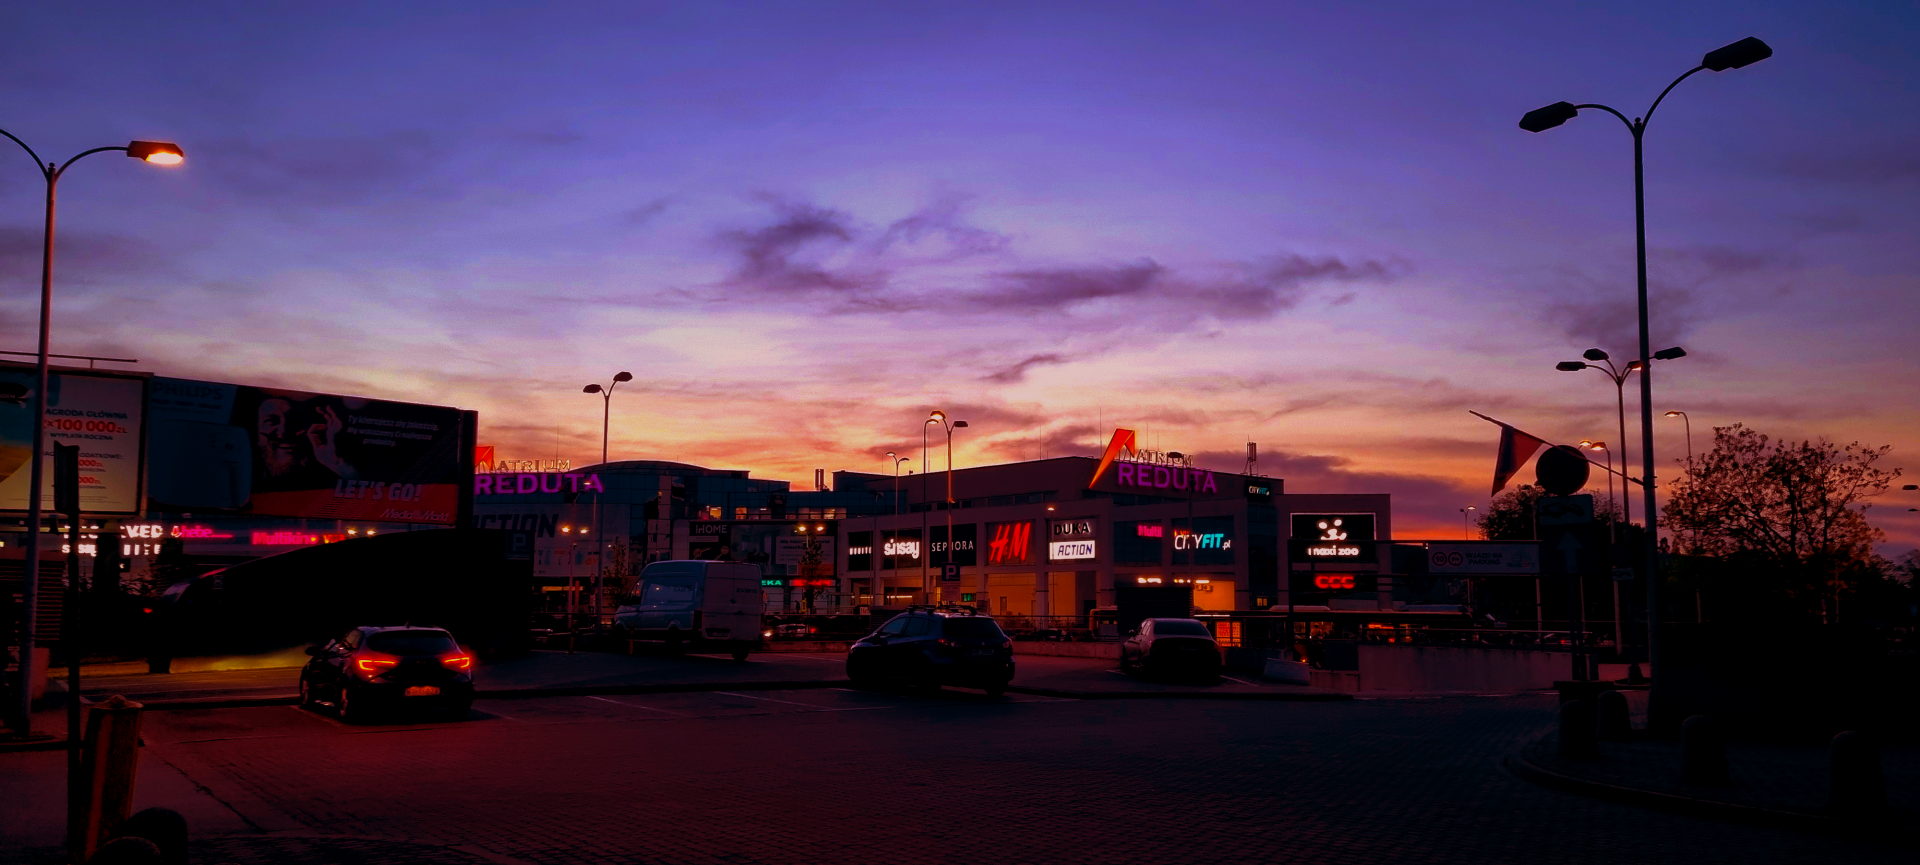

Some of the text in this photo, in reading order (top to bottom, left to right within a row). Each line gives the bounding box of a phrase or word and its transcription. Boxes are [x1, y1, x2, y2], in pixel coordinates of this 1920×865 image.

[152, 381, 223, 400] PHILIPS
[45, 408, 84, 417] AGRODA
[348, 415, 358, 424] Ty
[44, 418, 83, 432] x100
[497, 459, 571, 471] ATRIUM
[475, 473, 605, 495] REDUTA
[1118, 463, 1218, 494] REDUTA
[333, 479, 423, 502] LET'S GO!
[471, 513, 559, 538] CTION
[1054, 522, 1091, 535] DUKA
[512, 533, 527, 552] P
[884, 538, 920, 559] sinsay
[989, 522, 1032, 564] H&M
[1057, 543, 1093, 557] ACTION
[1337, 547, 1359, 556] zoo
[1435, 555, 1444, 563] 10
[945, 564, 957, 579] P
[1315, 576, 1356, 589] CCC
